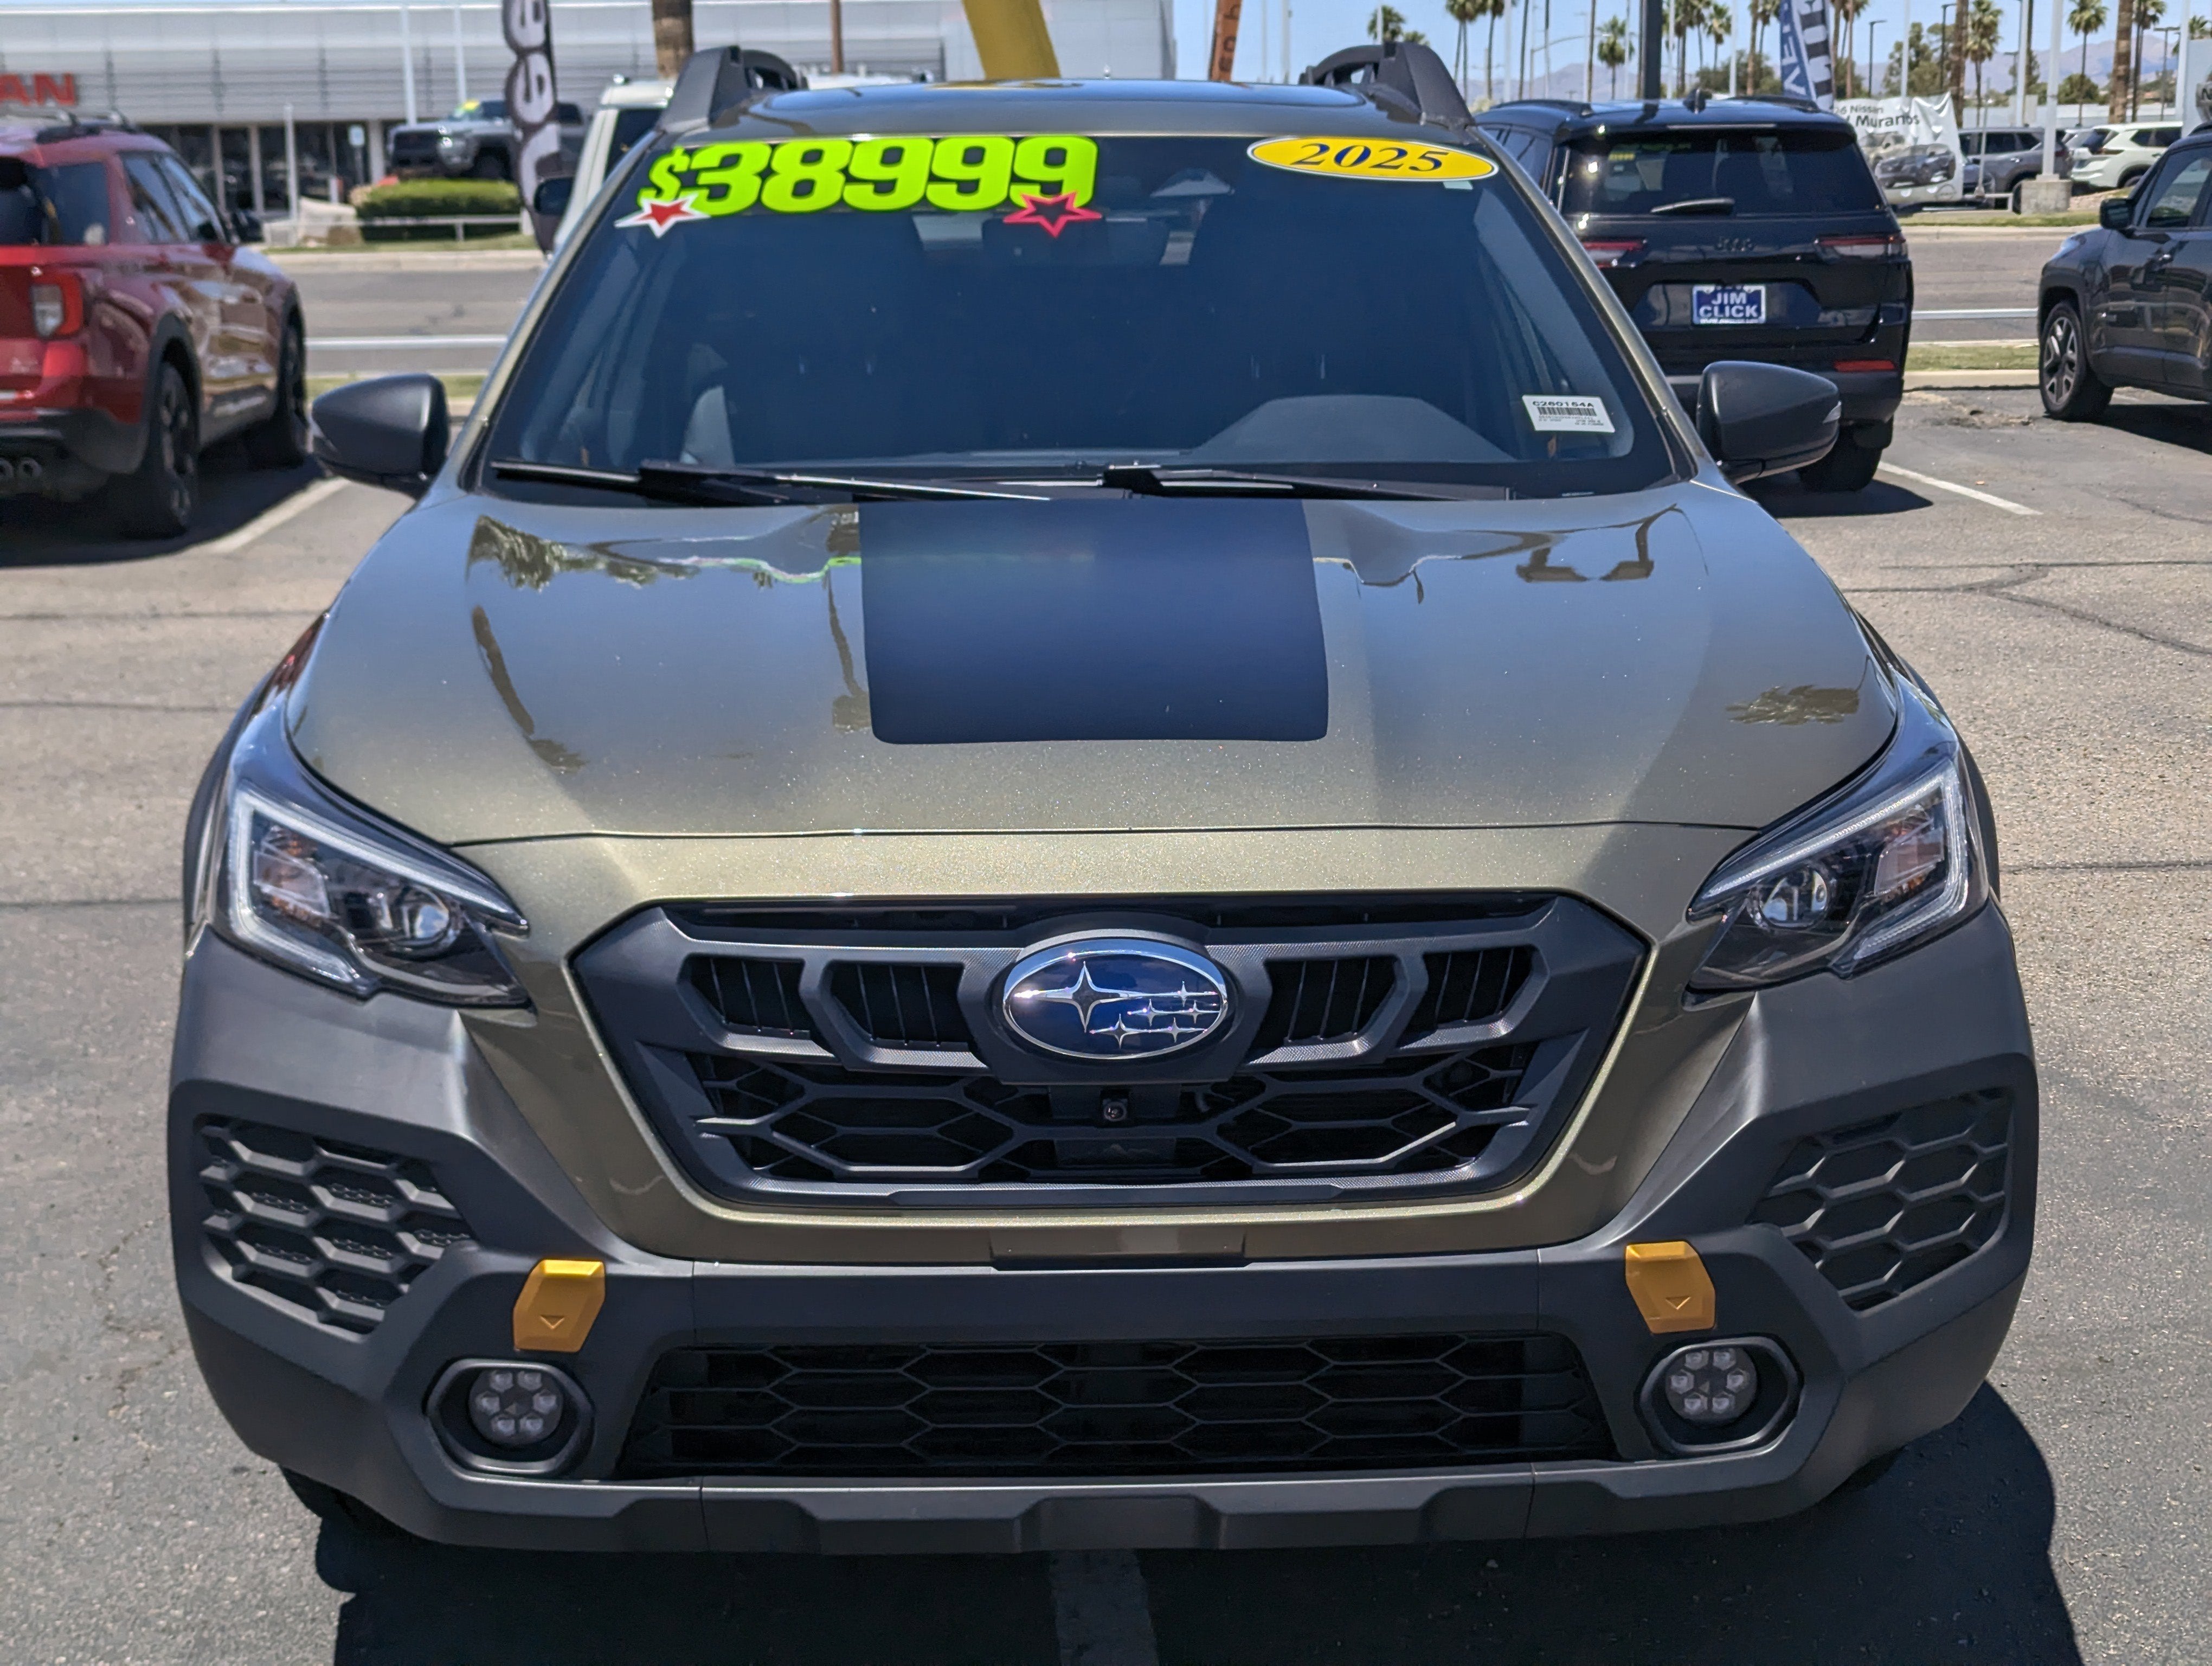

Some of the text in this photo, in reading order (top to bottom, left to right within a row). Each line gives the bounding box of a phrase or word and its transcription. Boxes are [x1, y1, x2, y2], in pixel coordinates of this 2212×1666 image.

[1856, 114, 1920, 128] Muranos
[1290, 143, 1449, 172] 2025
[638, 134, 1098, 217] $38999
[1711, 292, 1747, 305] JIM
[1699, 305, 1758, 318] CLICK
